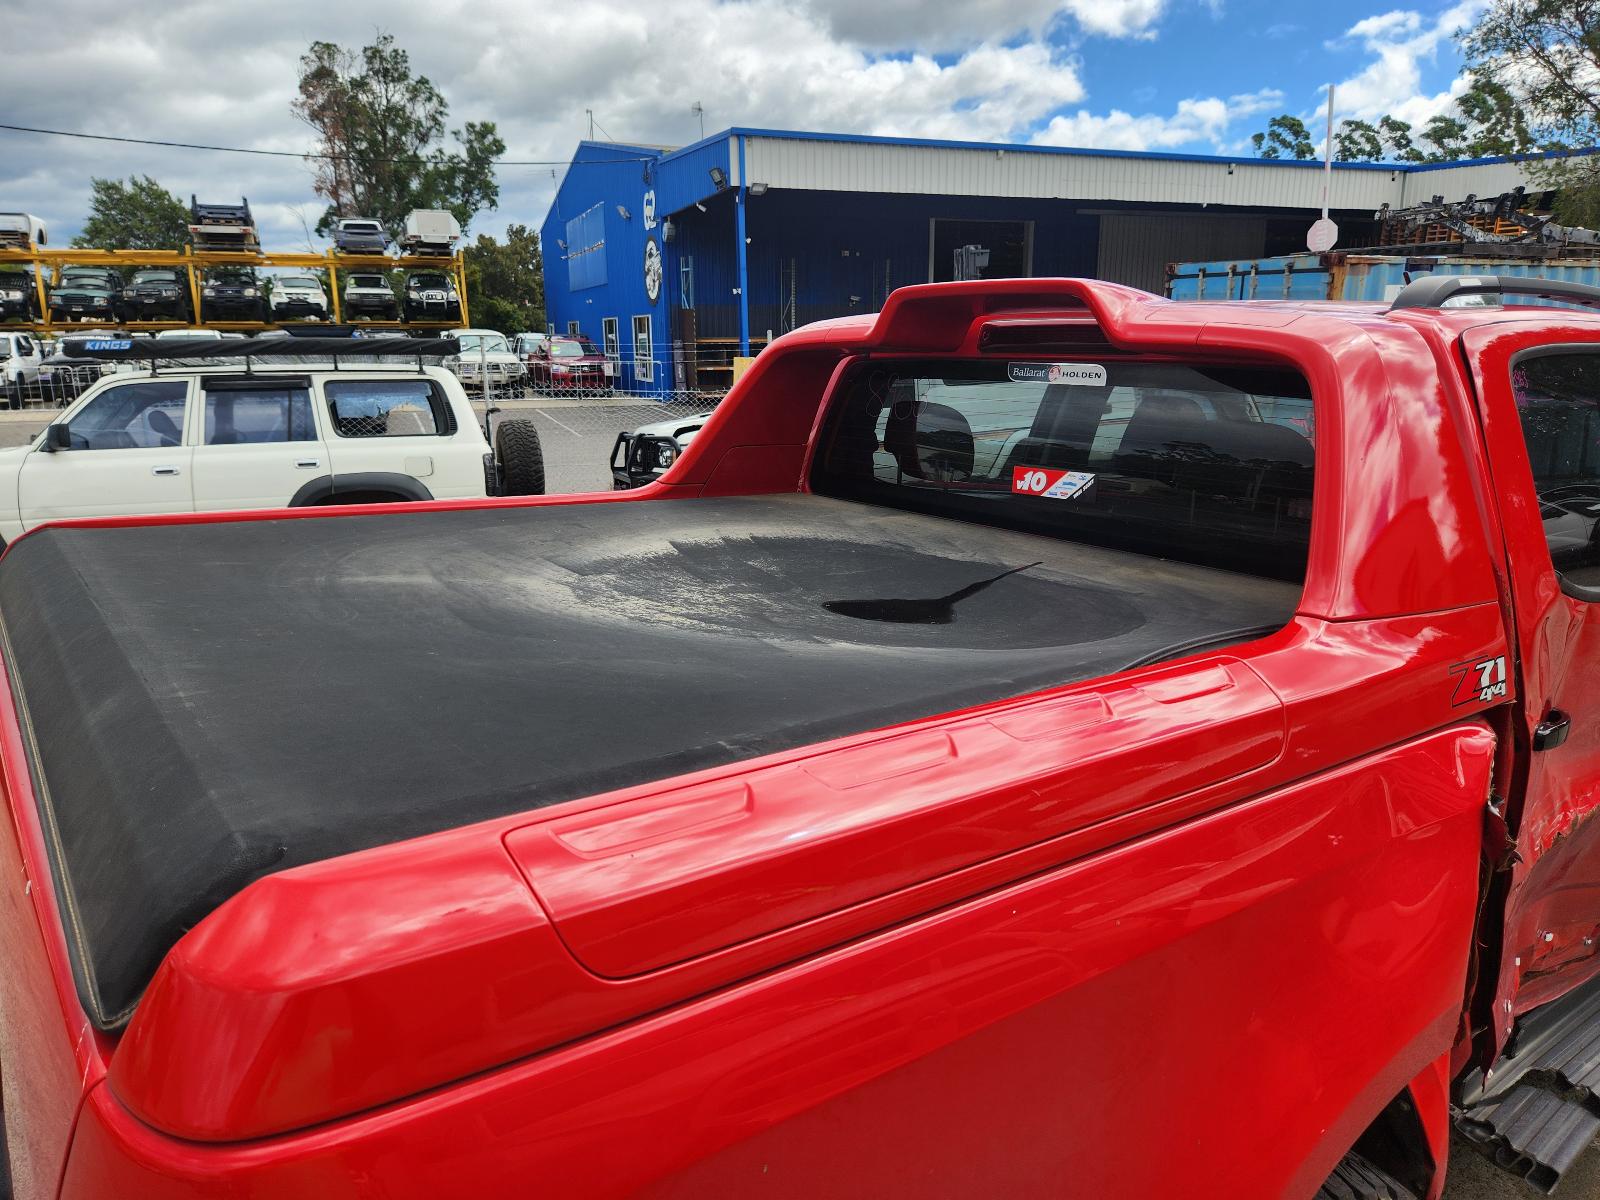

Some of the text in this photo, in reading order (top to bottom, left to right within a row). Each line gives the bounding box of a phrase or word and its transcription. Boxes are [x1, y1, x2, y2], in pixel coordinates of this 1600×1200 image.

[84, 340, 132, 350] KINGS
[1012, 367, 1102, 379] Ballarat HOLDEN
[1449, 654, 1506, 708] Z71
